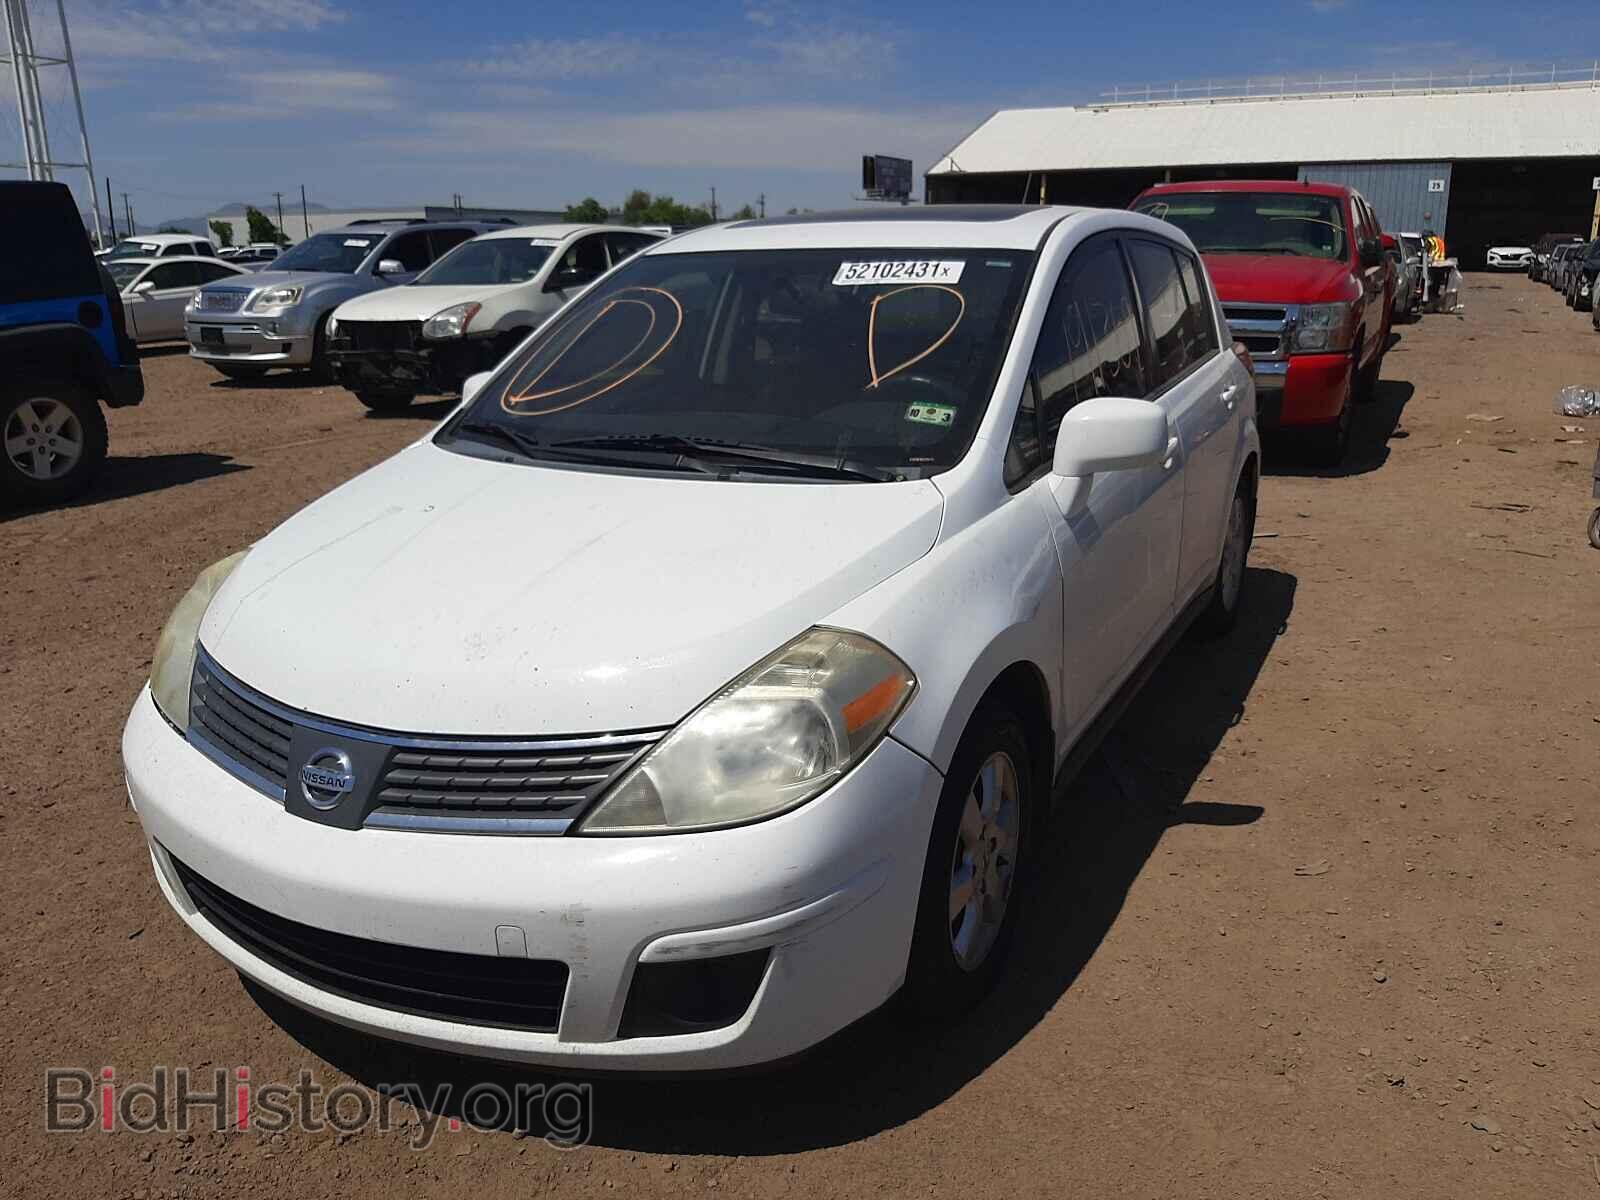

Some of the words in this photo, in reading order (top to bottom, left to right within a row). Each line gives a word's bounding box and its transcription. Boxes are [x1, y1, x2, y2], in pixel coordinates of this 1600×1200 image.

[909, 408, 921, 418] 10
[941, 413, 951, 422] 3
[301, 770, 346, 788] NISSAN
